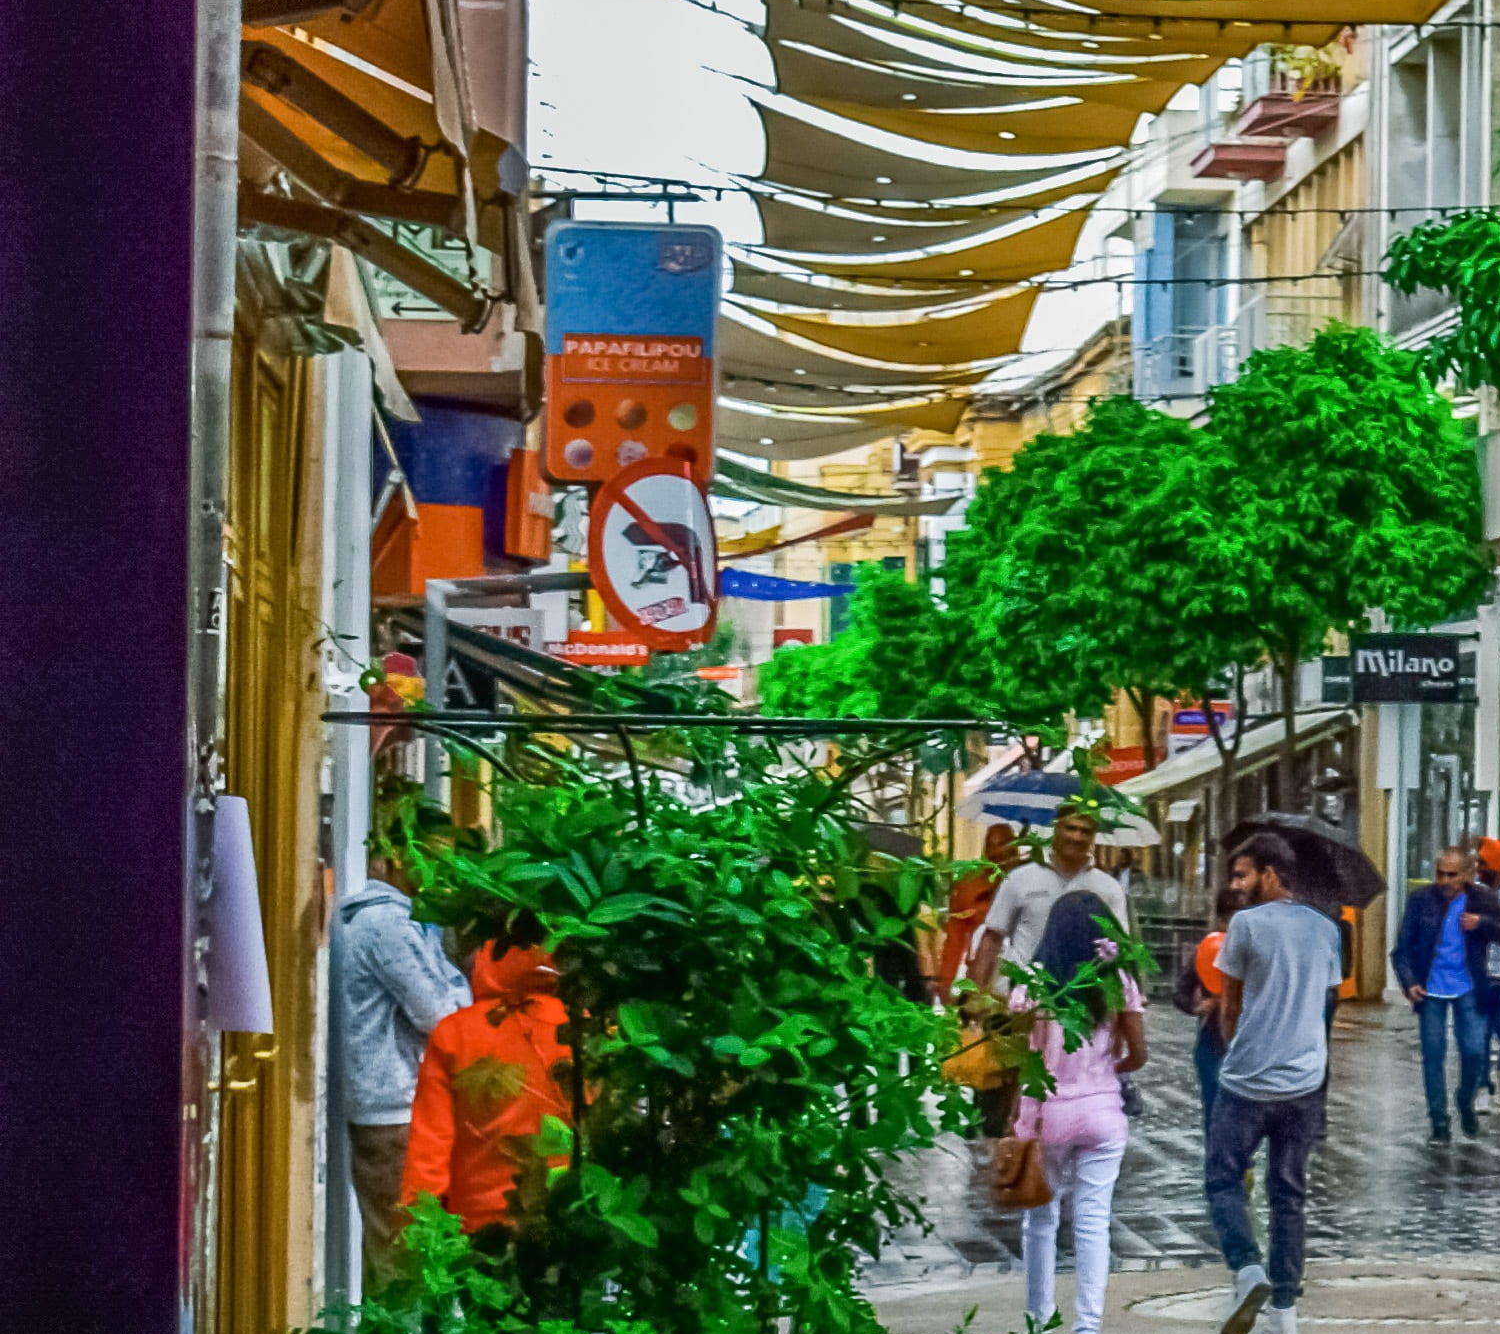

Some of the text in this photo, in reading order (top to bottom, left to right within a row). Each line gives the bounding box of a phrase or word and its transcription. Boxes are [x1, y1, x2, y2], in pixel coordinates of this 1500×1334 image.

[588, 358, 680, 373] ICE CREAM
[1357, 649, 1455, 677] Milano
